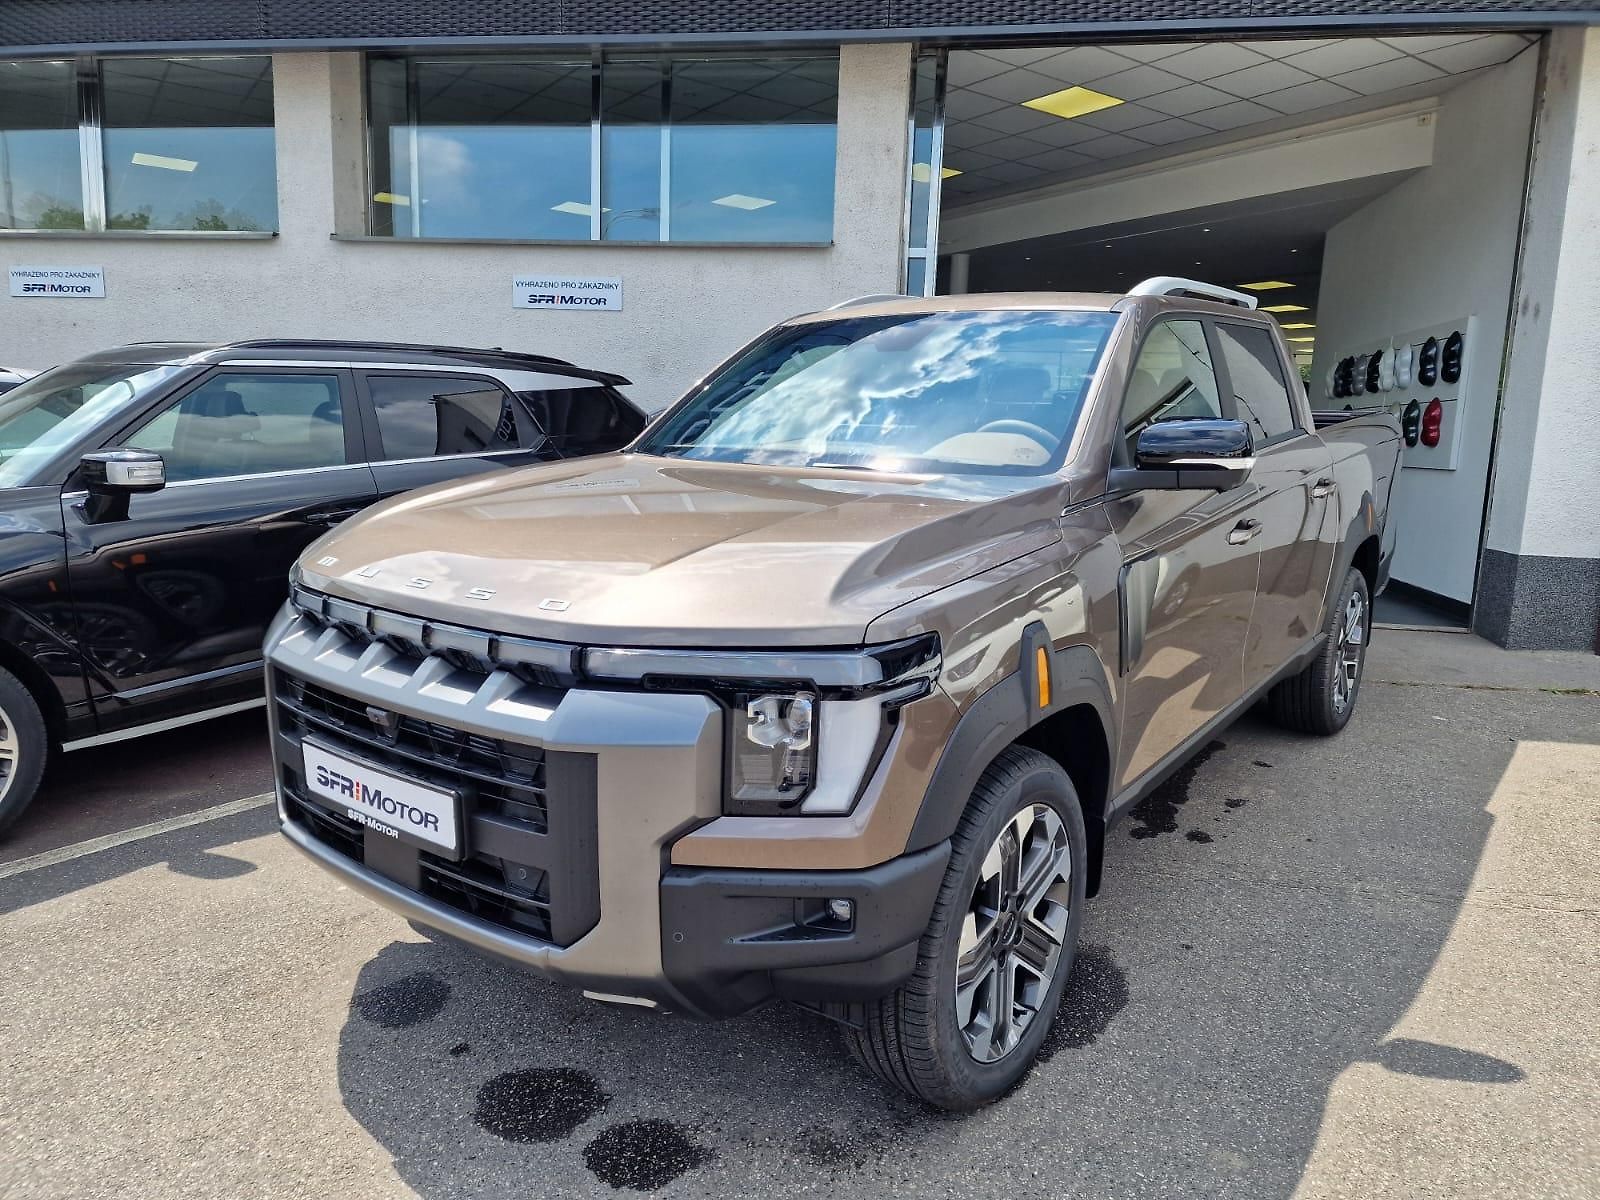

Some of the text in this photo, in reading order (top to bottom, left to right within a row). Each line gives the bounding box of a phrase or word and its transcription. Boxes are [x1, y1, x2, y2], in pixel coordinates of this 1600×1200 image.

[515, 281, 559, 289] VYHRAZENO
[561, 281, 576, 289] PRO
[317, 556, 572, 611] MUSSO
